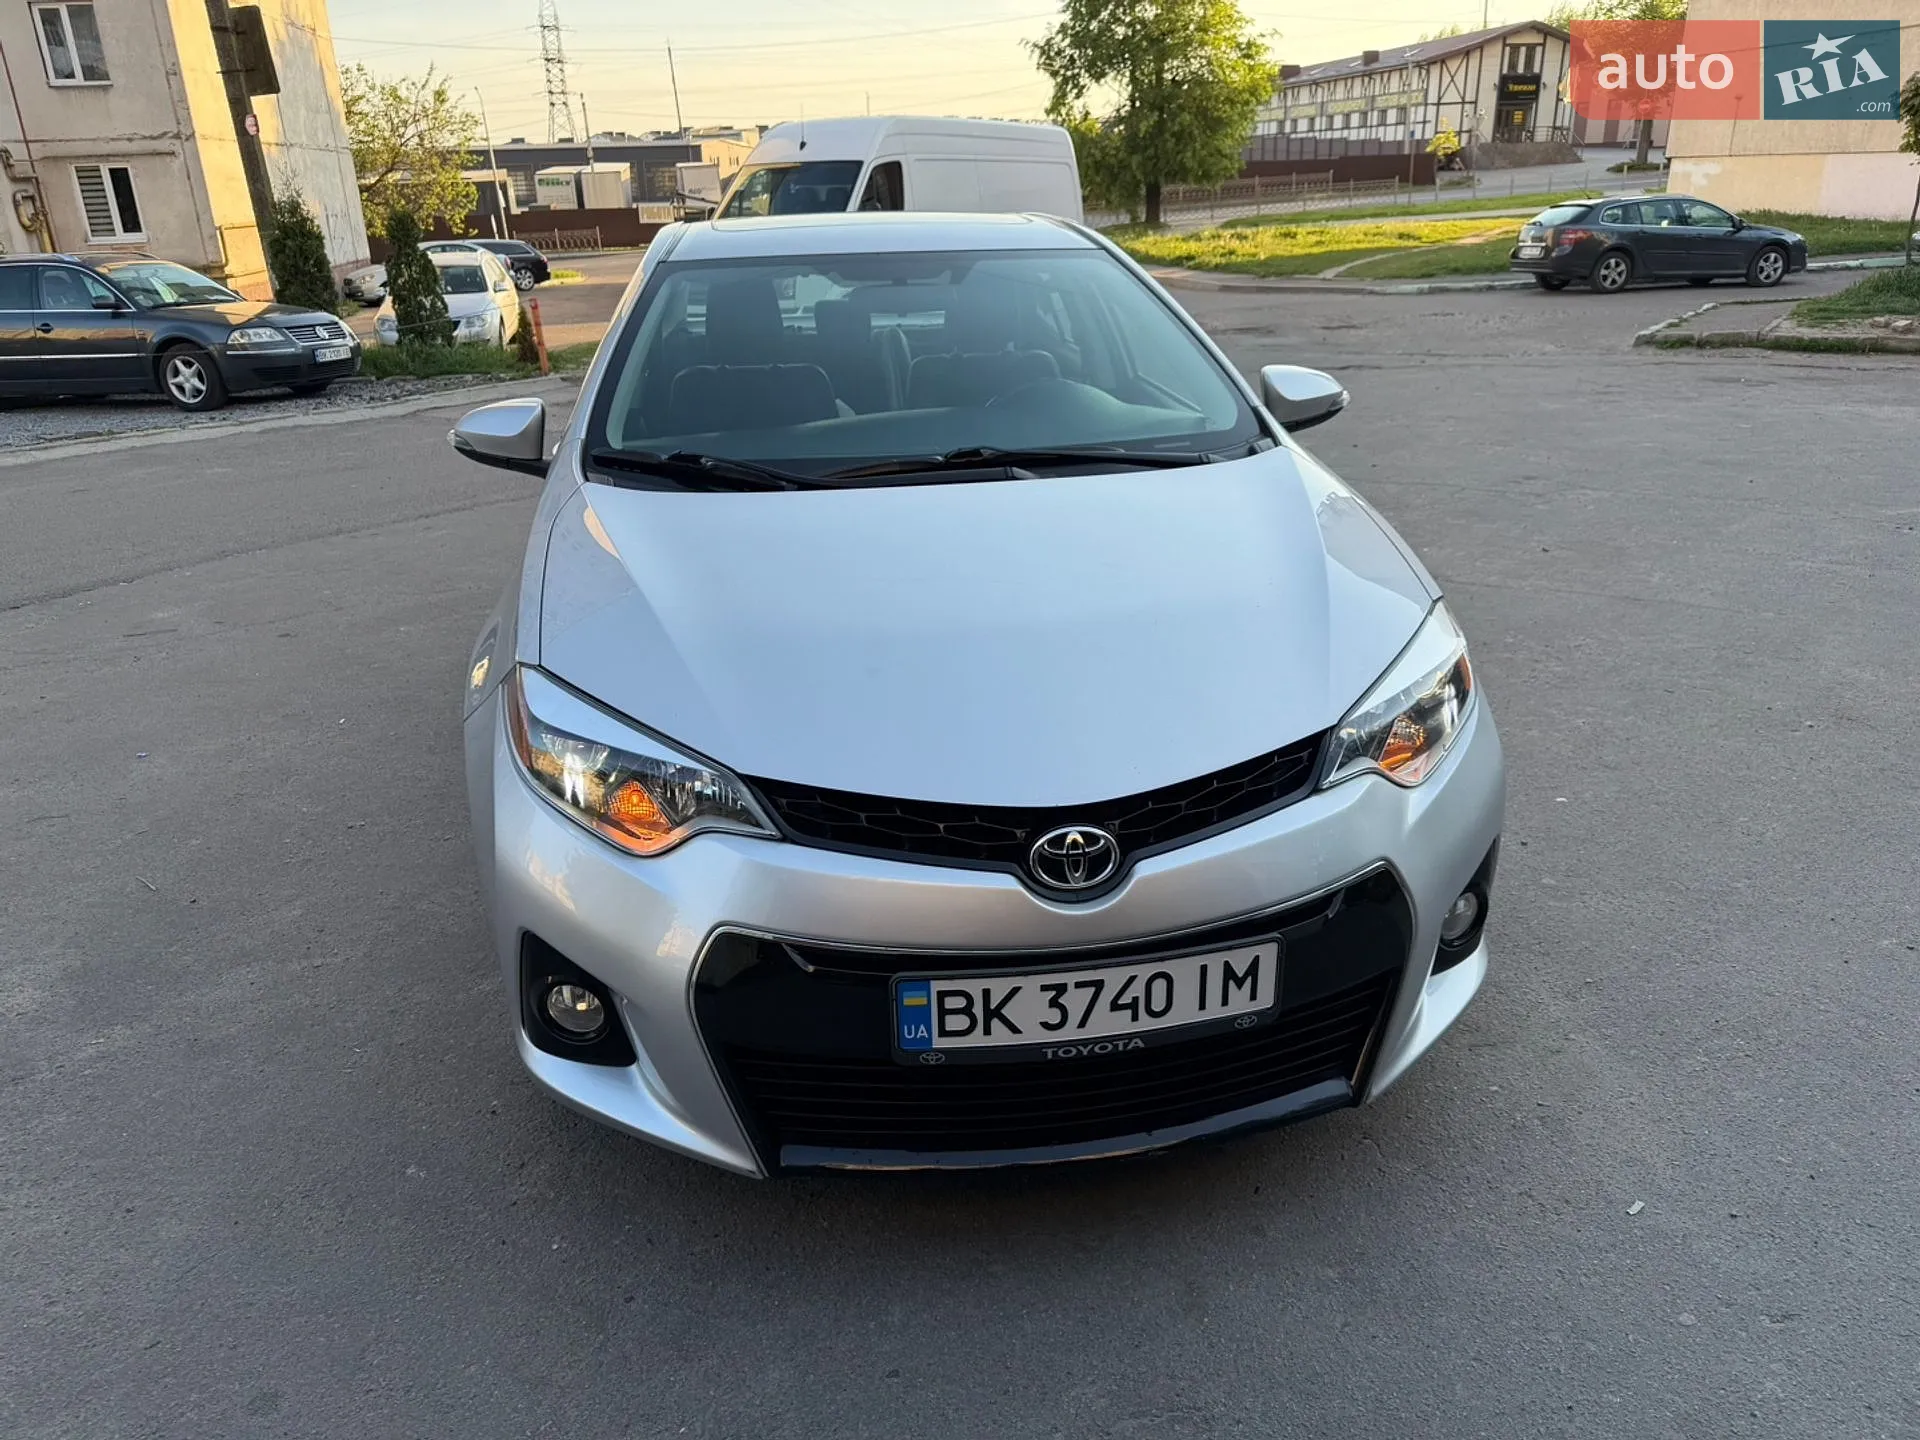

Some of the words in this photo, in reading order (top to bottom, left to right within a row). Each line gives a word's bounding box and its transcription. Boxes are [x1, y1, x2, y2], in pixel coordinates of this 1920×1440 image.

[936, 985, 1023, 1039] BK
[1038, 970, 1174, 1032] 3740
[1198, 954, 1261, 1011] IM
[903, 1023, 928, 1040] UA
[1041, 1037, 1145, 1060] TOYOTA
